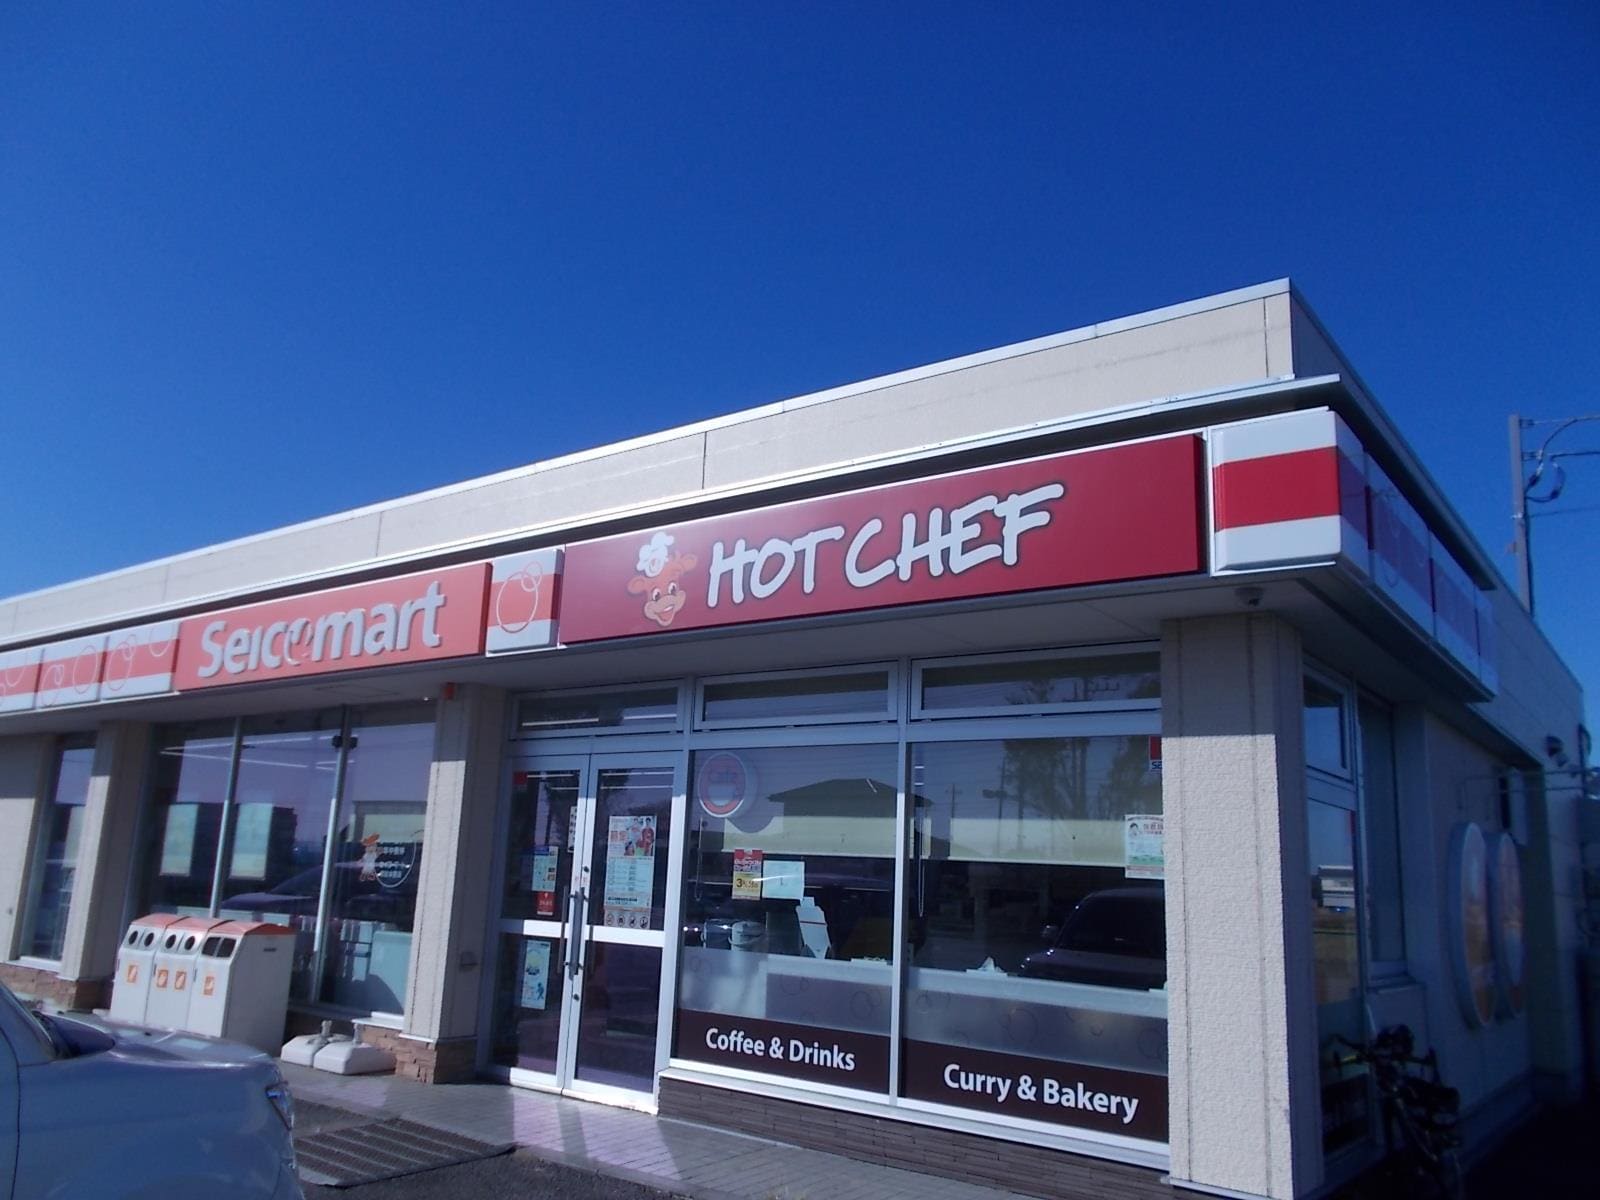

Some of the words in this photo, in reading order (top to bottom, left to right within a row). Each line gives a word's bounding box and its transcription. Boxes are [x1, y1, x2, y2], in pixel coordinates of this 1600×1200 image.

[706, 525, 846, 609] HOT
[844, 482, 1066, 588] CHEF
[197, 580, 448, 678] Seicomart
[705, 1027, 765, 1057] Coffee
[768, 1036, 784, 1060] &
[789, 1039, 856, 1071] Drinks
[943, 1063, 1012, 1103] Curry
[1016, 1074, 1037, 1102] &
[1043, 1078, 1139, 1124] Bakery
